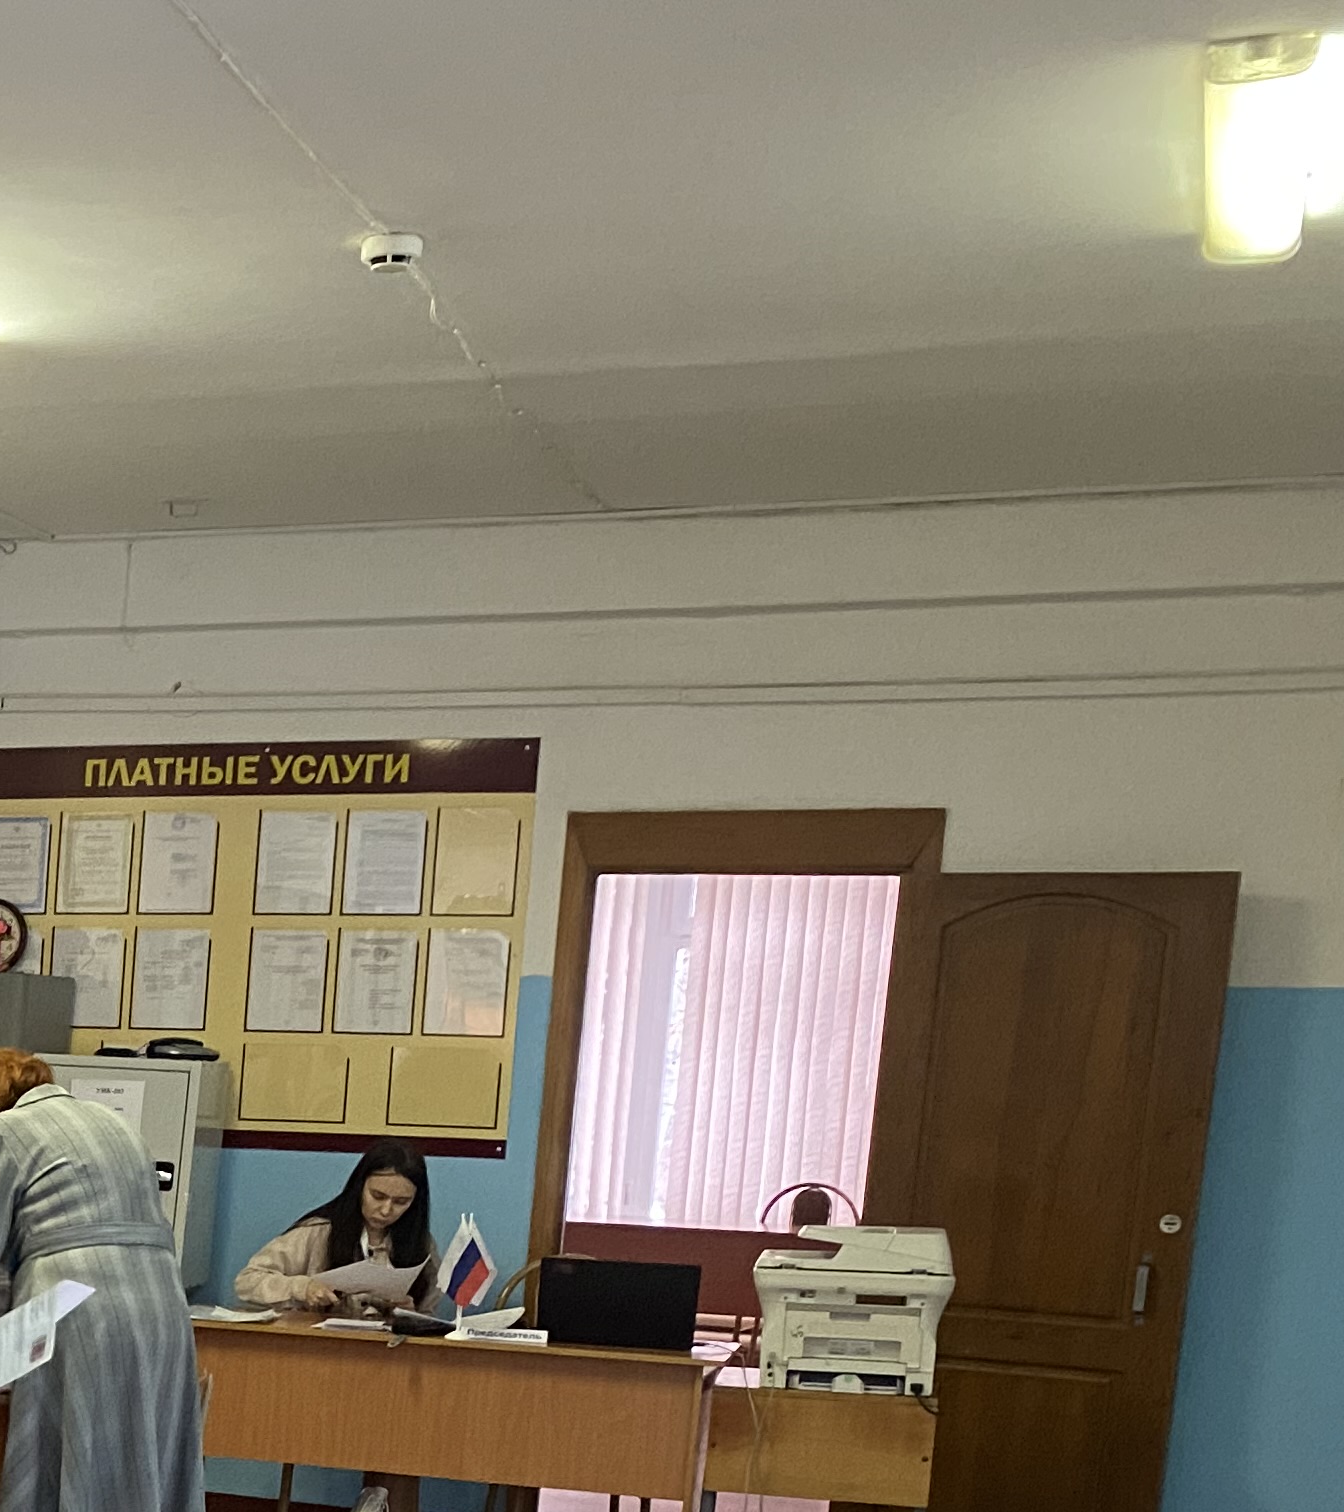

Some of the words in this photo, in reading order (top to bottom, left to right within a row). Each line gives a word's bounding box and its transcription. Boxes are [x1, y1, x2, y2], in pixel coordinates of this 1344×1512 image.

[84, 754, 261, 788] ПЛАТНЫЕ
[269, 752, 411, 785] УСЛУГИ
[467, 1327, 543, 1340] Председатель
